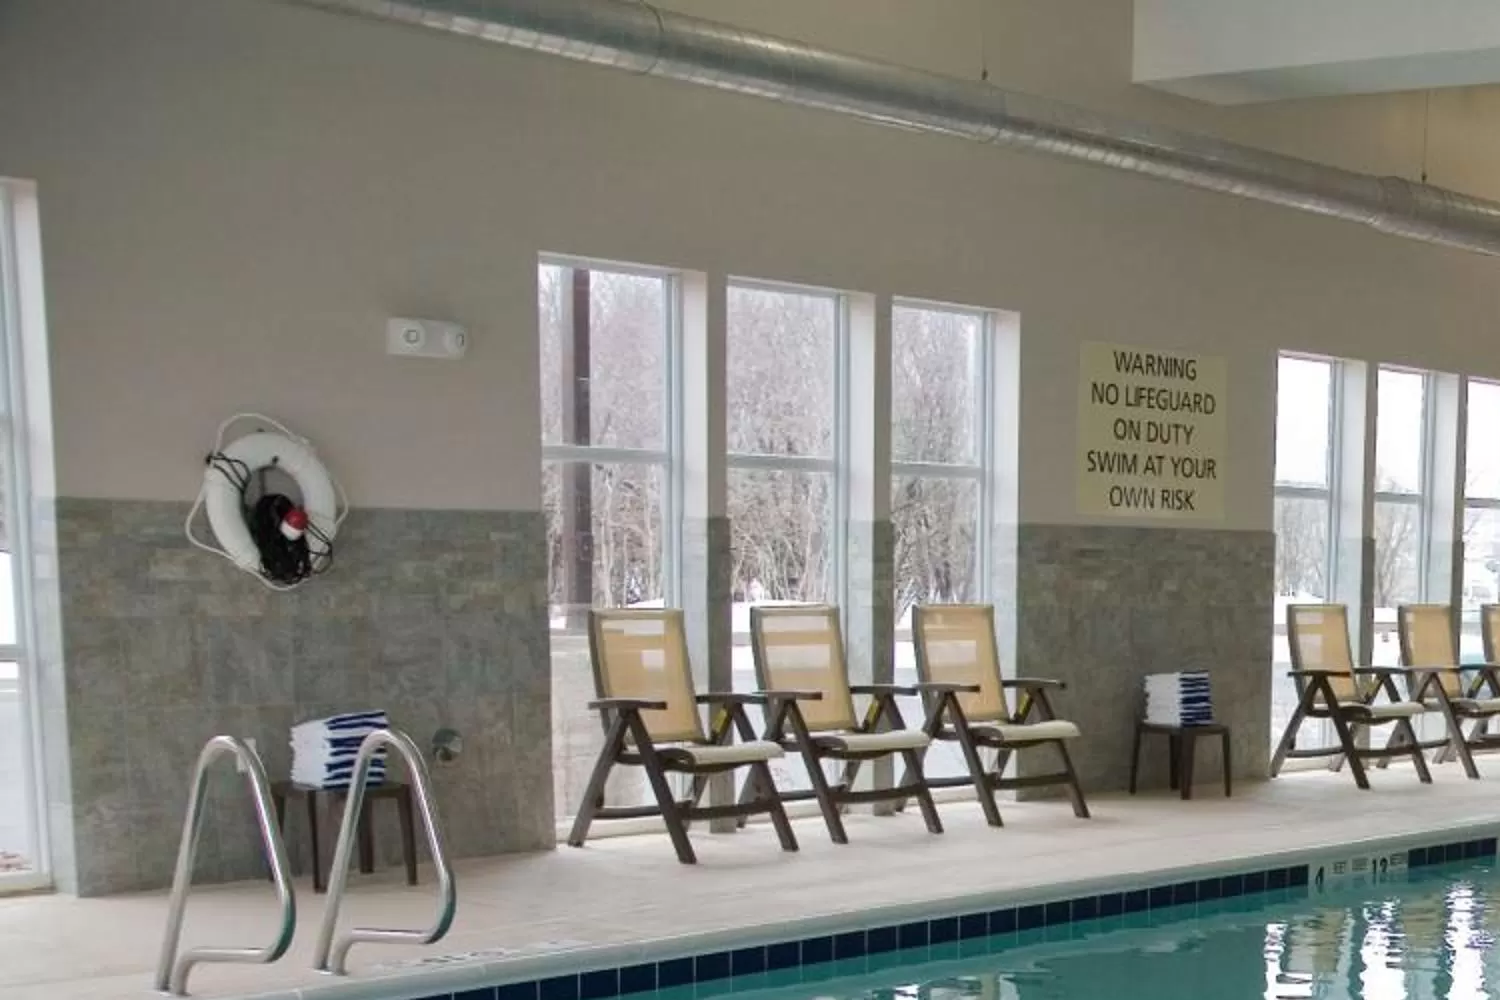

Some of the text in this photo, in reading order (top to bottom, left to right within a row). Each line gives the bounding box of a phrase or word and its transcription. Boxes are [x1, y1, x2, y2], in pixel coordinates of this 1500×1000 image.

[1114, 350, 1197, 381] WARNING
[1091, 382, 1216, 415] NO LIFEGUARD
[1113, 418, 1195, 445] ON DUTY
[1087, 450, 1217, 480] SWIM AT YOUR
[1109, 485, 1195, 511] OWN RISK
